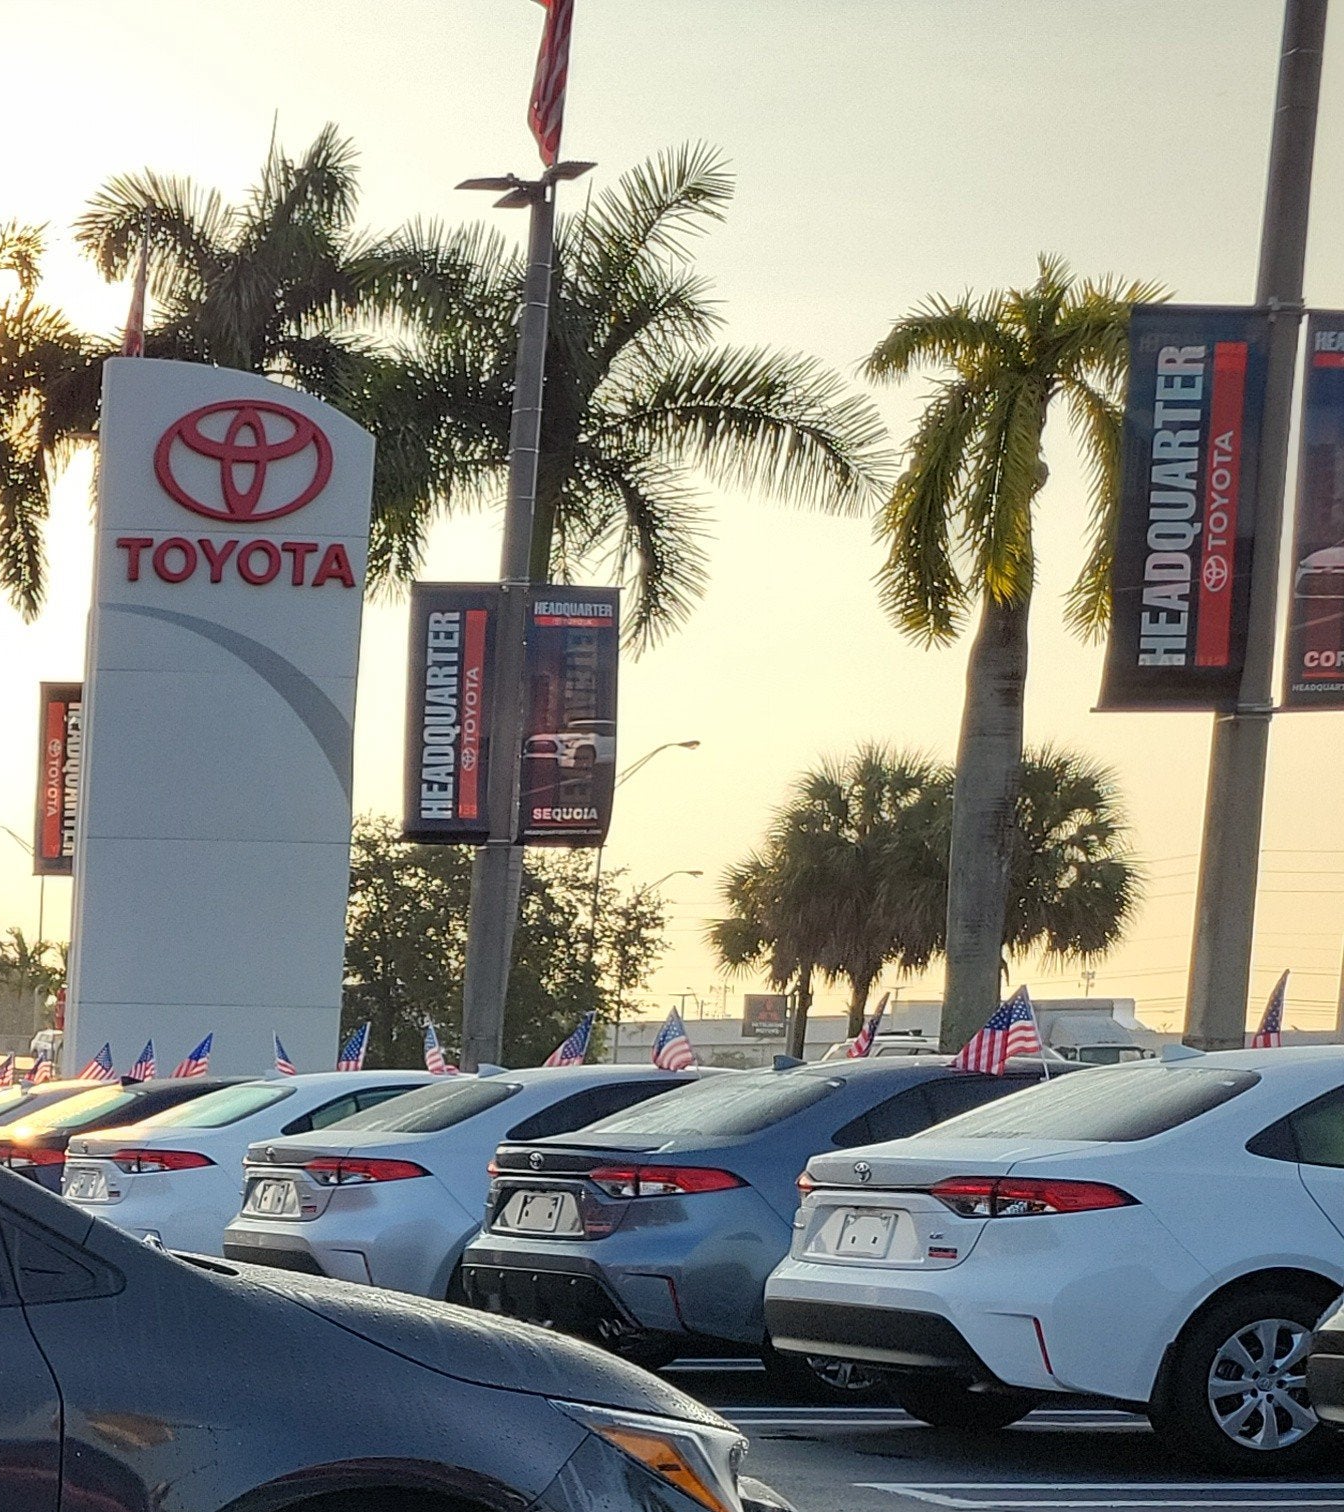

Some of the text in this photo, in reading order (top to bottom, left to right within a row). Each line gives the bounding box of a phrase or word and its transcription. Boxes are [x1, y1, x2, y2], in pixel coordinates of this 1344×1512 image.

[1138, 345, 1206, 666] HEADQUARTER
[1208, 430, 1234, 550] TOYOTA
[116, 537, 356, 588] TOYOTA
[534, 602, 612, 616] HEADQUARTER
[421, 612, 461, 819] HEADQUARTER
[464, 667, 480, 744] TOYOTA
[47, 760, 61, 817] TOYOTA
[533, 808, 598, 821] SEQUOIA
